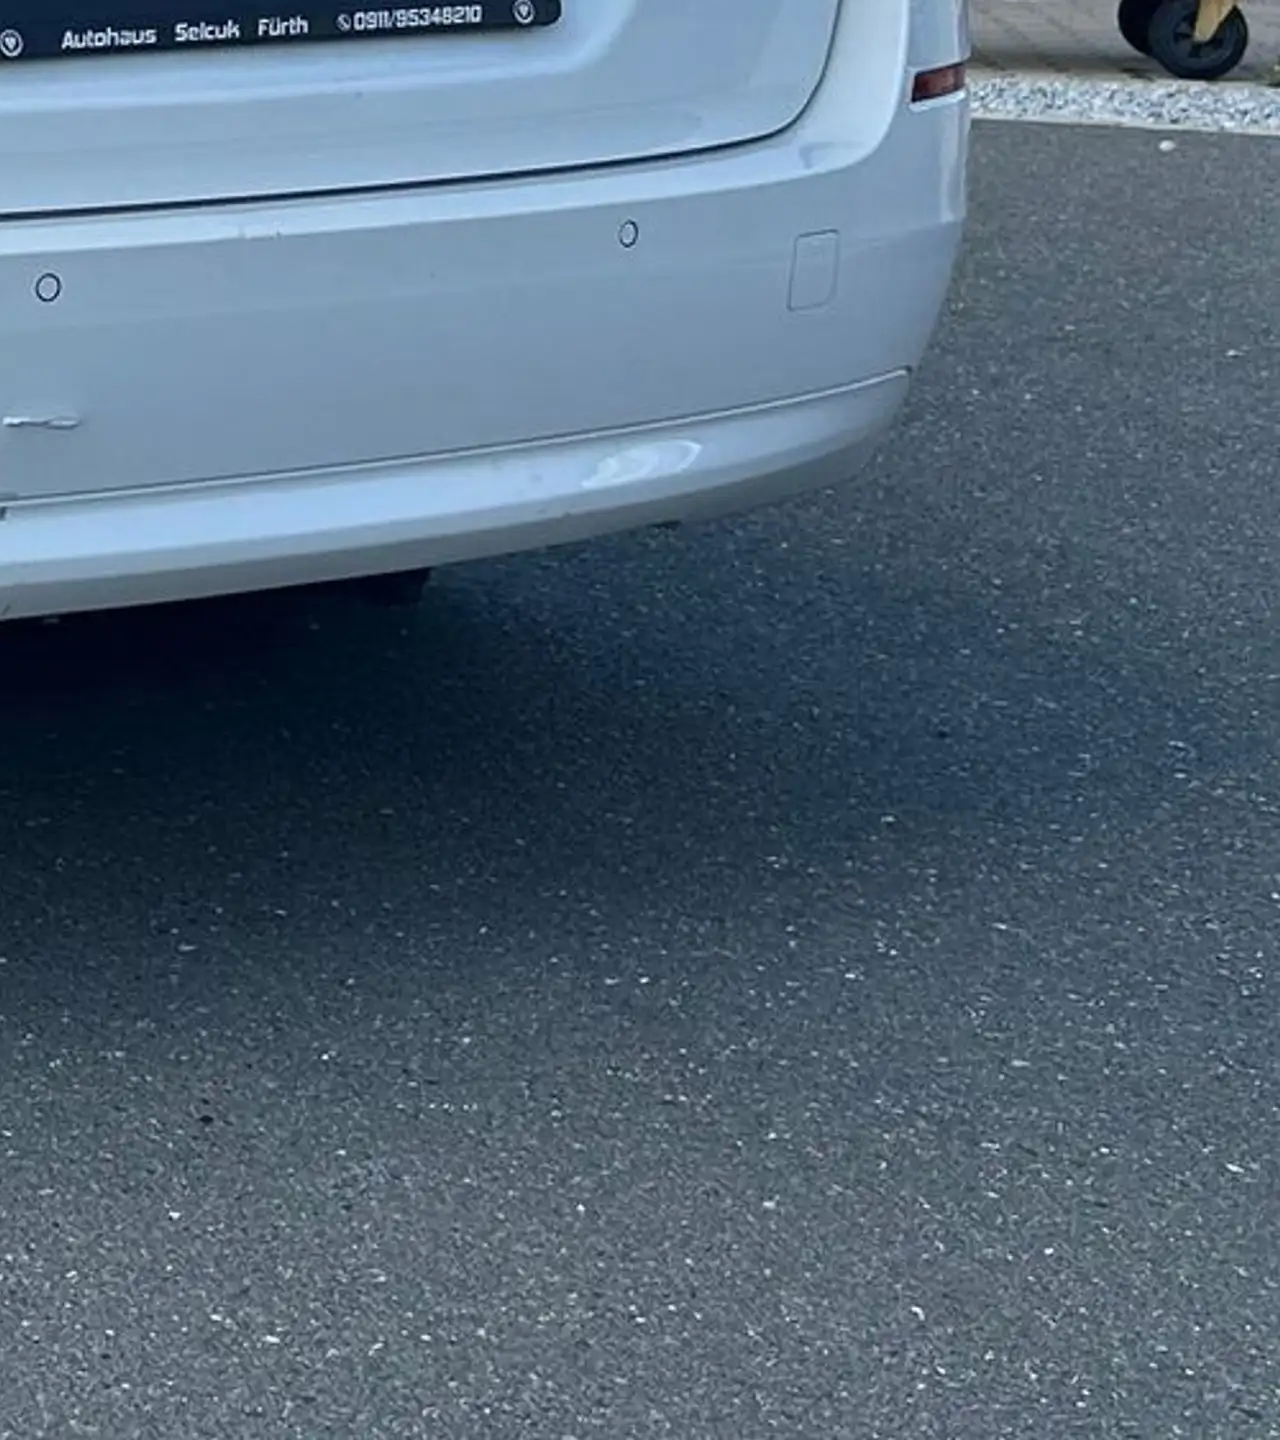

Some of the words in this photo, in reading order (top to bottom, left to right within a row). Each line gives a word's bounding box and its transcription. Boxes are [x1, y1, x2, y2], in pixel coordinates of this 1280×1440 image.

[61, 26, 158, 50] Autohaus
[174, 19, 241, 42] Selcuk
[257, 16, 309, 37] Fürth
